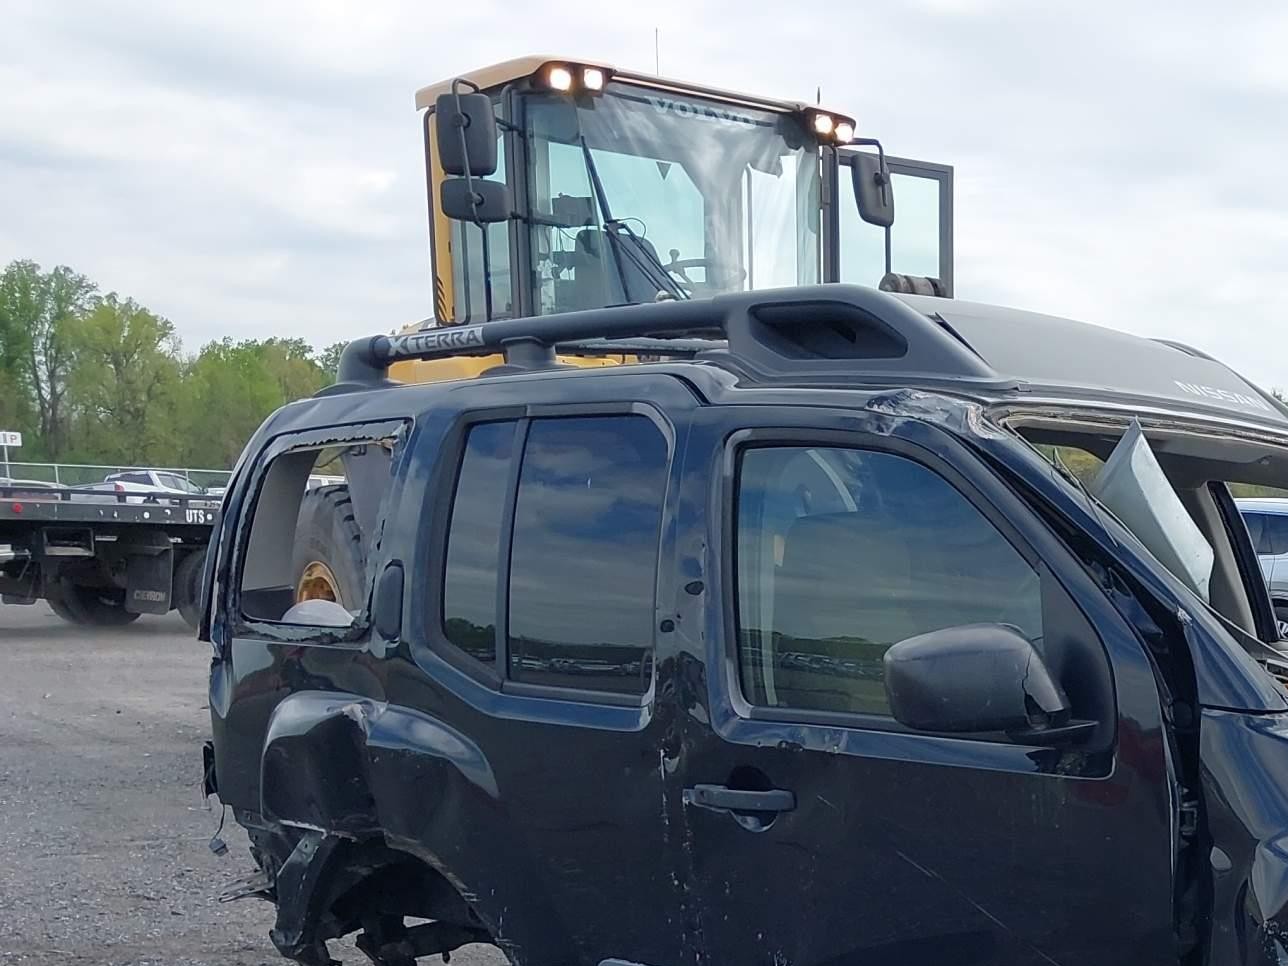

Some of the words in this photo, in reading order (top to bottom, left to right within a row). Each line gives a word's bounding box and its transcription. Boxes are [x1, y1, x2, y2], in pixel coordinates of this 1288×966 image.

[388, 328, 482, 357] XTERRA
[1173, 380, 1270, 411] NISSAN
[185, 508, 205, 524] UTS
